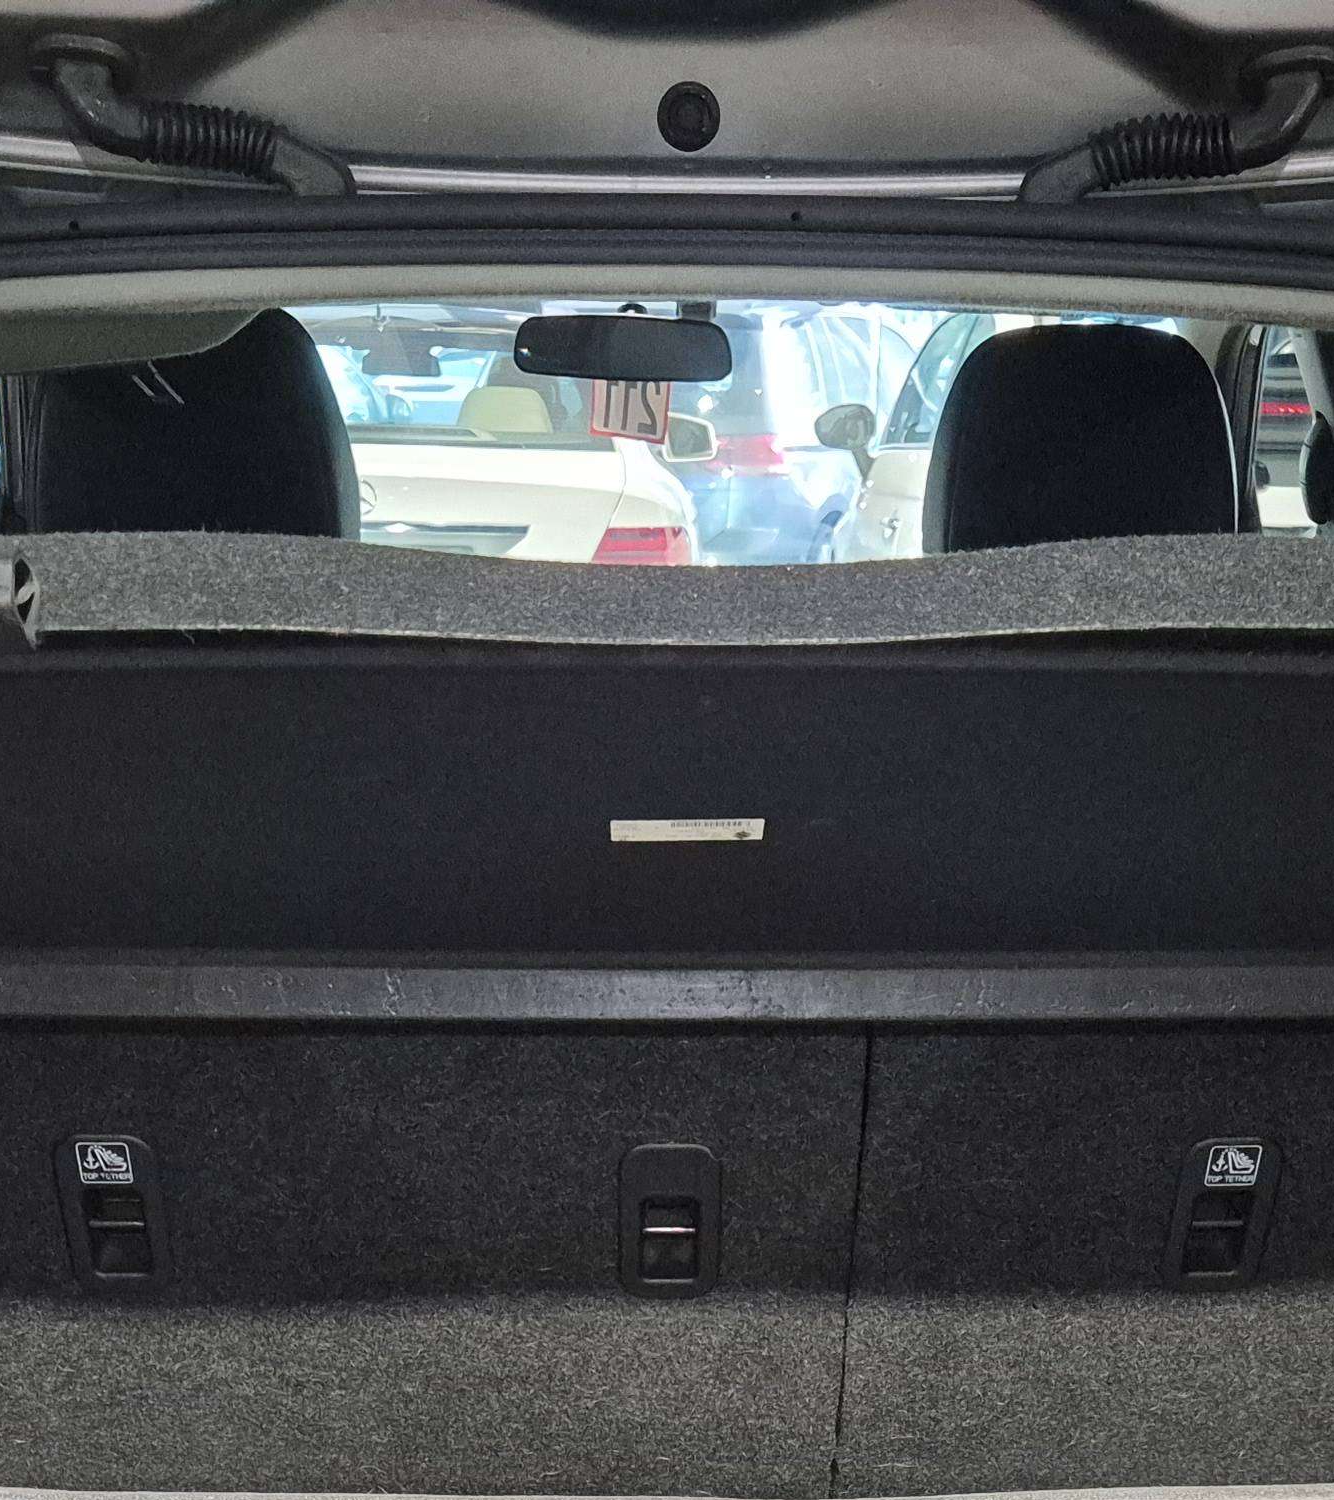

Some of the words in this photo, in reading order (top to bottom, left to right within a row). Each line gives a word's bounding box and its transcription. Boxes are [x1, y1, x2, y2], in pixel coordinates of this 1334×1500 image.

[82, 1172, 99, 1181] TOP
[1207, 1175, 1223, 1183] TOP
[1224, 1175, 1255, 1183] TETHER
